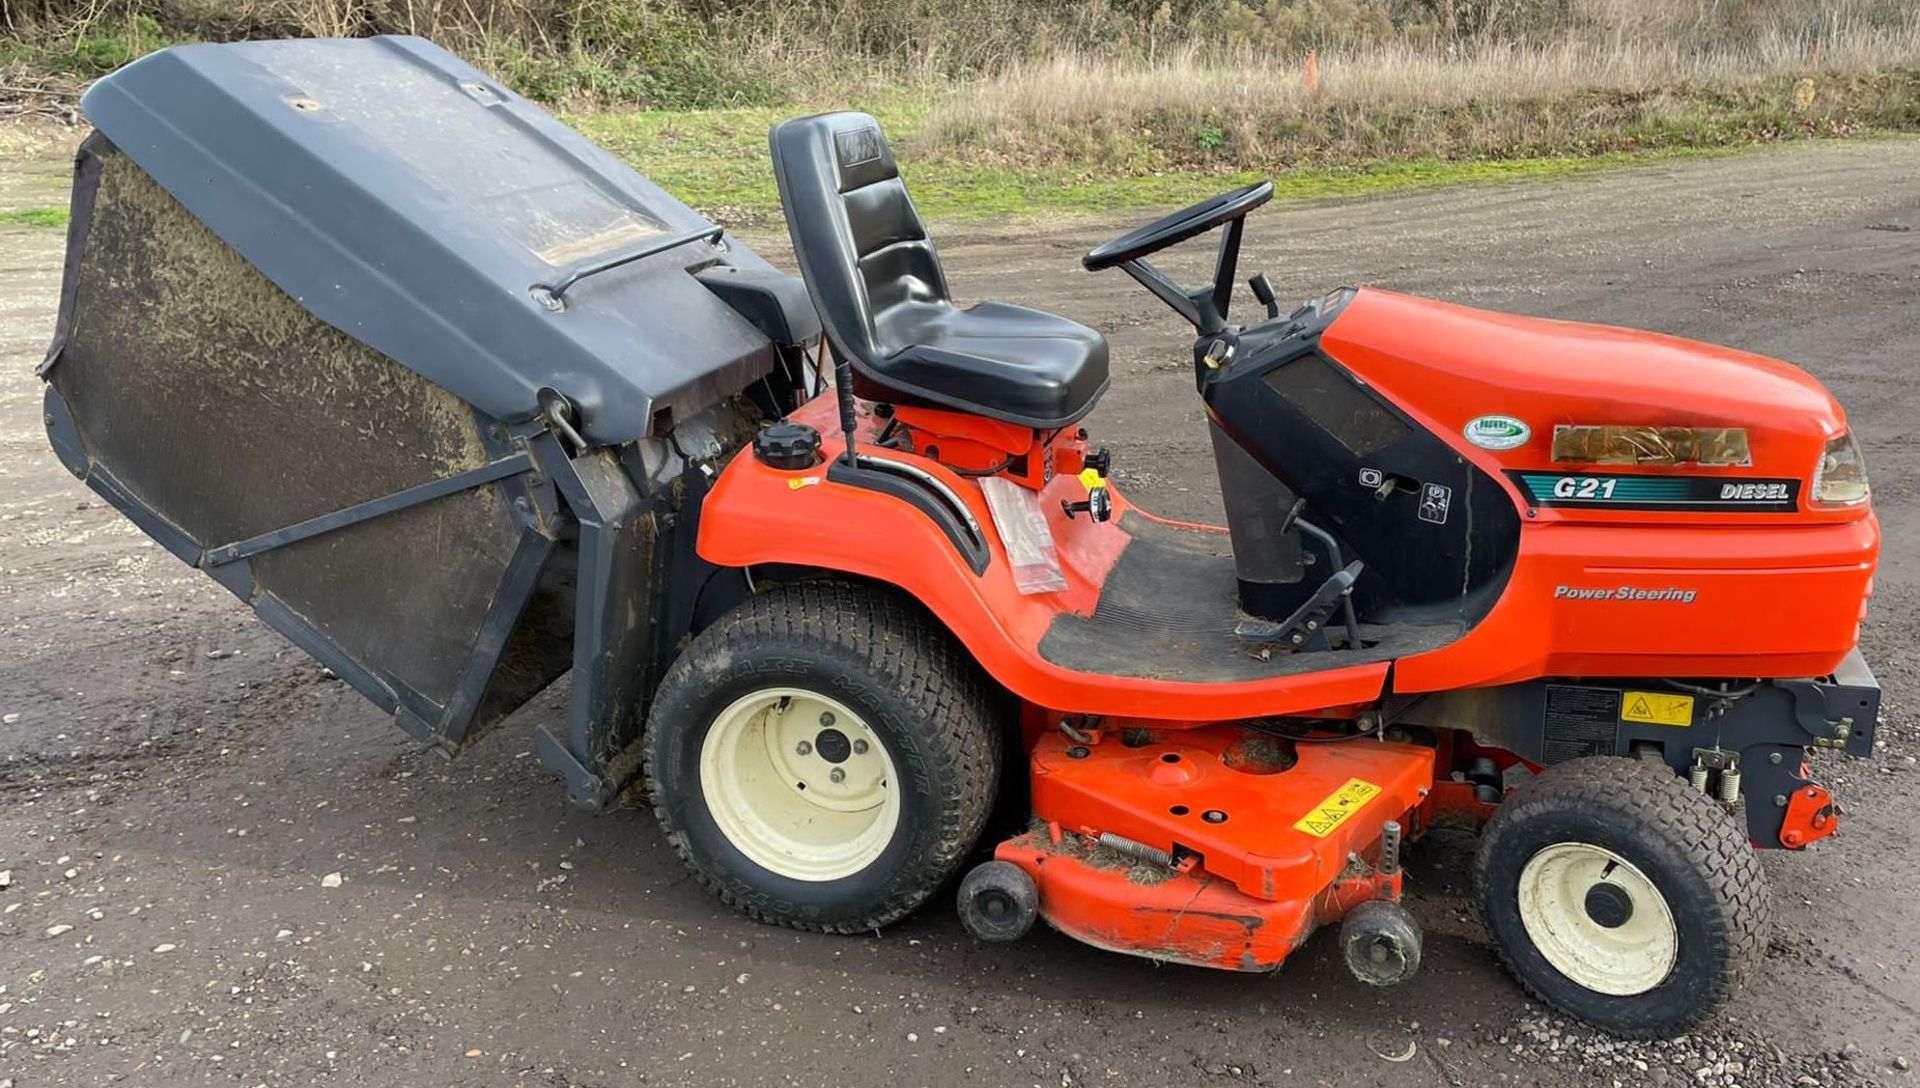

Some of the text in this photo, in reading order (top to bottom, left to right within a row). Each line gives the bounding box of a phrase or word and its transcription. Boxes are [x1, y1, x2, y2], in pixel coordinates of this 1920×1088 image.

[1553, 476, 1618, 499] G21
[1720, 483, 1789, 499] DIESEL
[831, 674, 931, 797] MASTER
